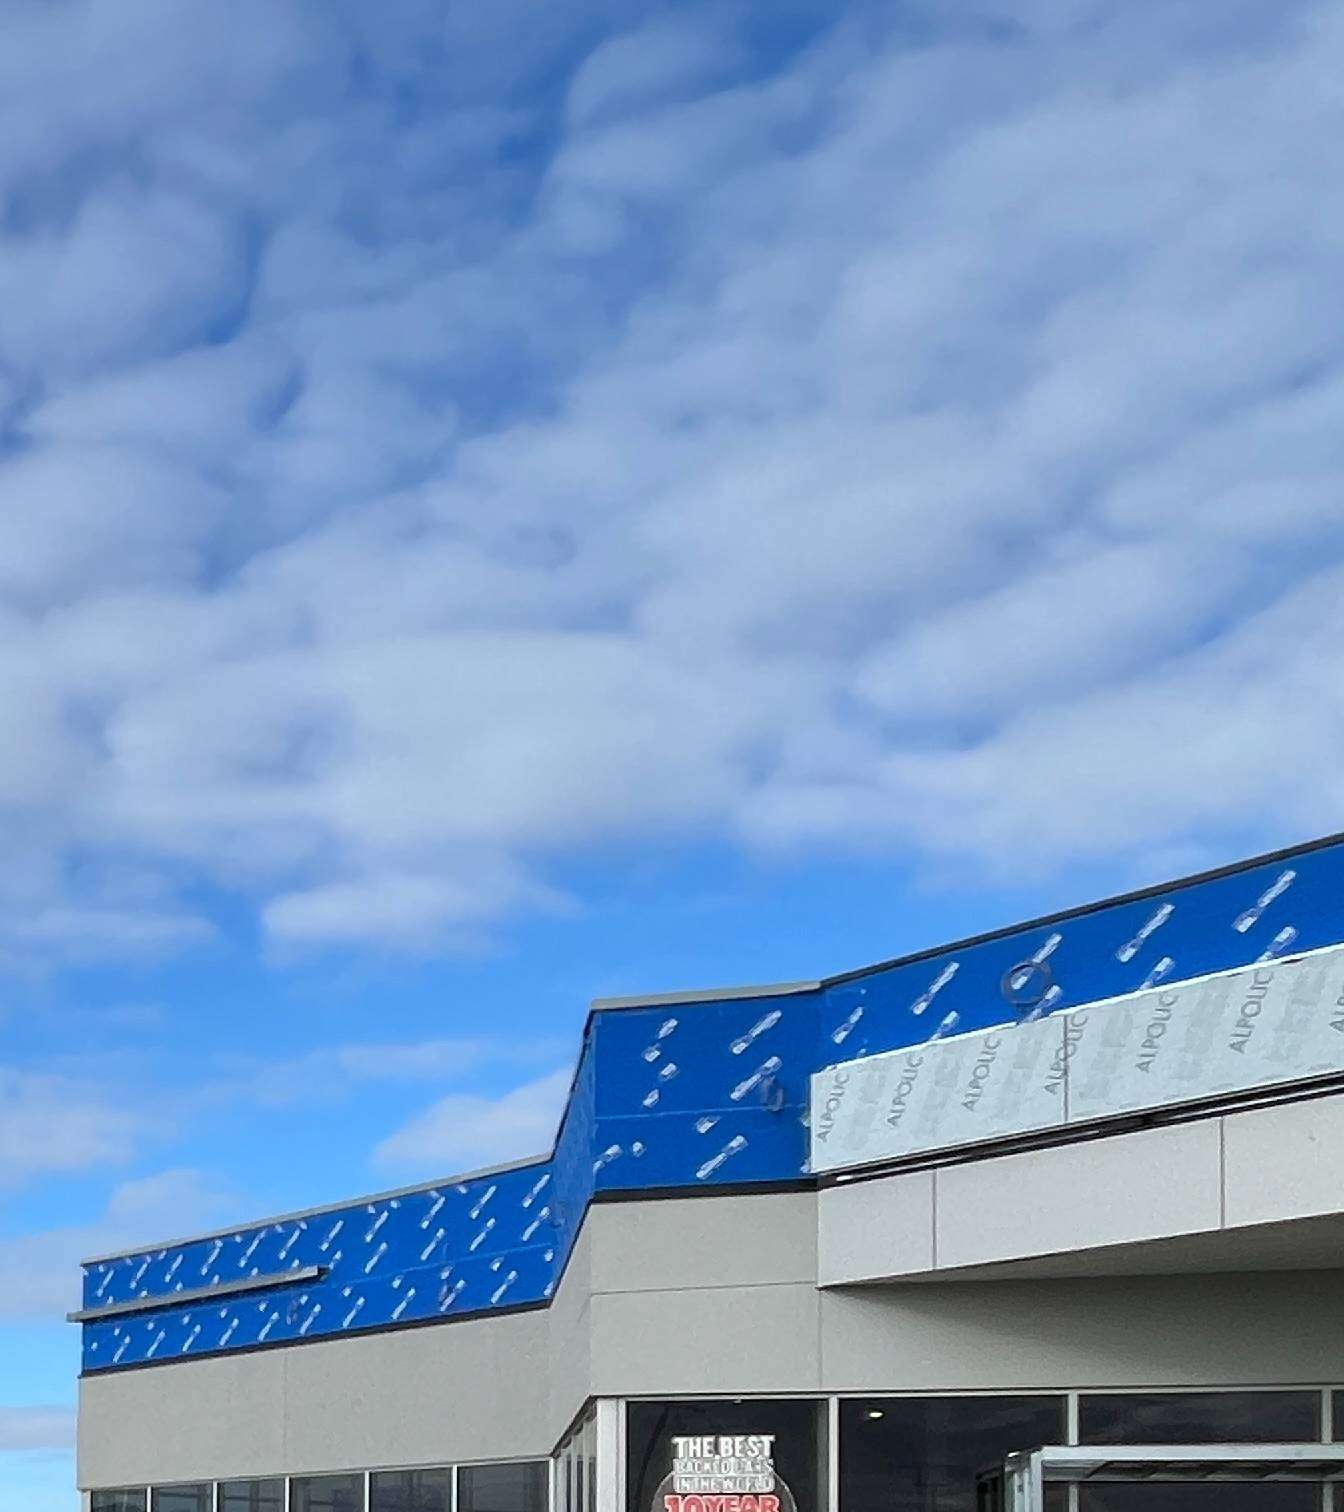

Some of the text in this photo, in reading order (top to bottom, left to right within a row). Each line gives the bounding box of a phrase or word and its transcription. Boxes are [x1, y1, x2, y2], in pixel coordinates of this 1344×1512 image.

[1134, 990, 1179, 1073] ALPOLIC
[1227, 969, 1274, 1054] ALPOLIC
[886, 1052, 923, 1128] ALPOLIC
[962, 1036, 1001, 1112] ALPOLIC
[1043, 1010, 1089, 1095] ALPOLIC
[816, 1072, 850, 1142] ALPOLIC
[672, 1435, 776, 1458] THE BEST
